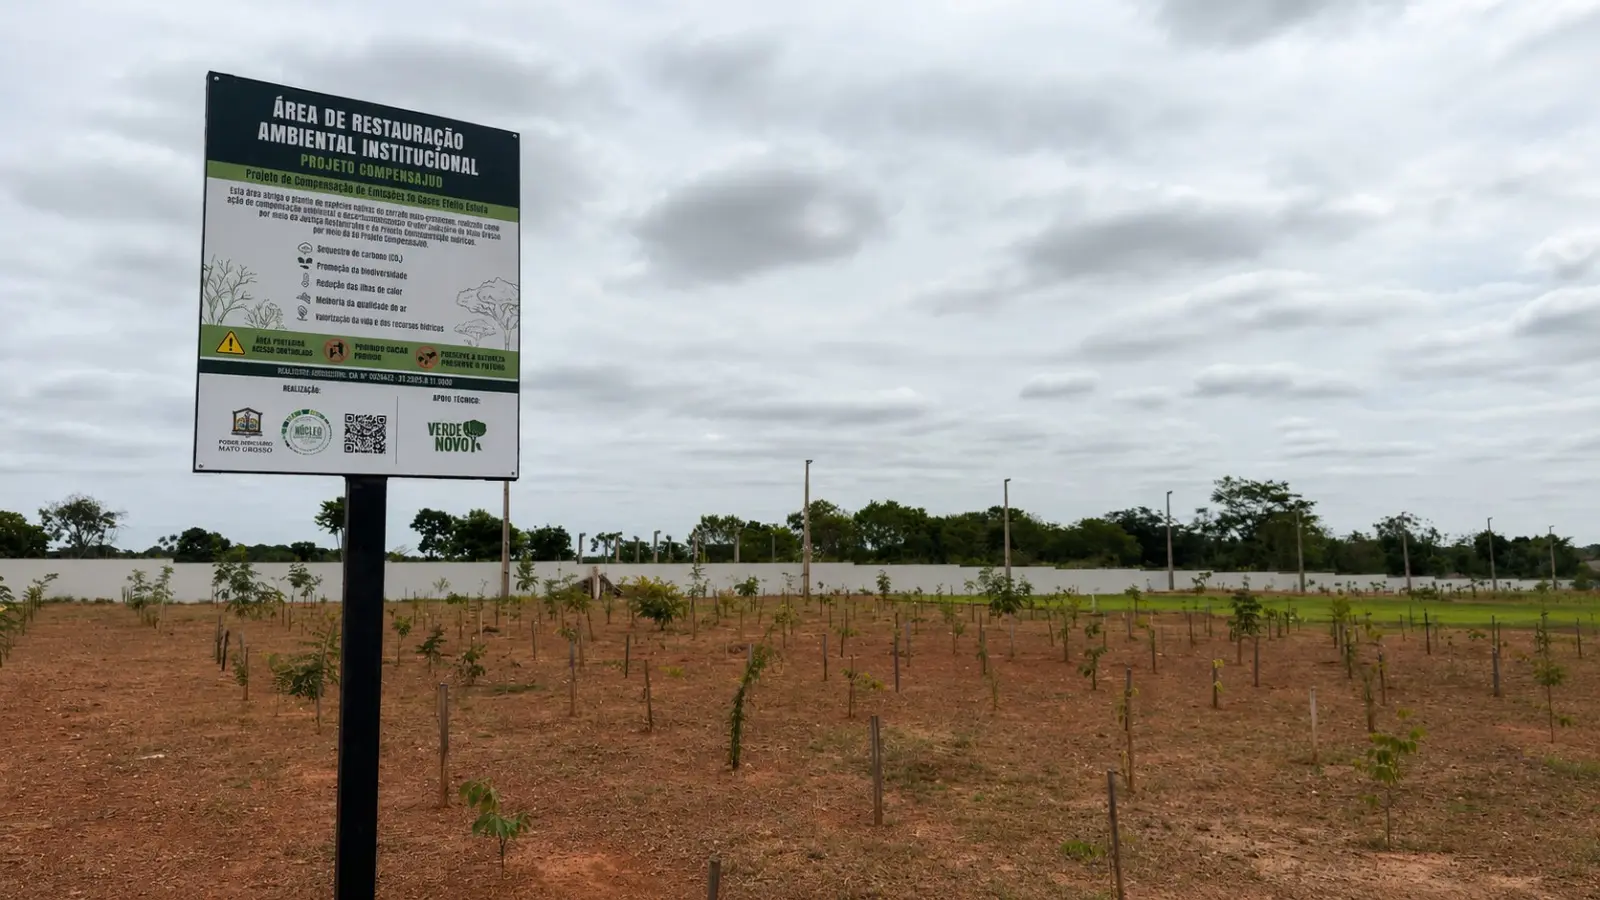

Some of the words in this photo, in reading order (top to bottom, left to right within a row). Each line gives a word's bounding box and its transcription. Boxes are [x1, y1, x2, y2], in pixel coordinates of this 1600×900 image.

[272, 96, 319, 124] ÁREA
[324, 107, 346, 129] DE
[352, 114, 463, 151] RESTAURAÇÃO
[258, 122, 357, 154] AMBIENTAL
[361, 138, 478, 176] INSTITUCIONAL
[246, 167, 278, 183] Projeto
[281, 173, 291, 183] de
[294, 175, 352, 194] Compensação
[356, 185, 365, 196] de
[300, 154, 354, 174] PROJETO
[358, 163, 442, 188] COMPENSAJUD
[346, 281, 358, 290] das
[282, 384, 320, 395] REALIZAÇÃO:
[428, 422, 462, 436] VERDE
[435, 437, 469, 452] NOVO
